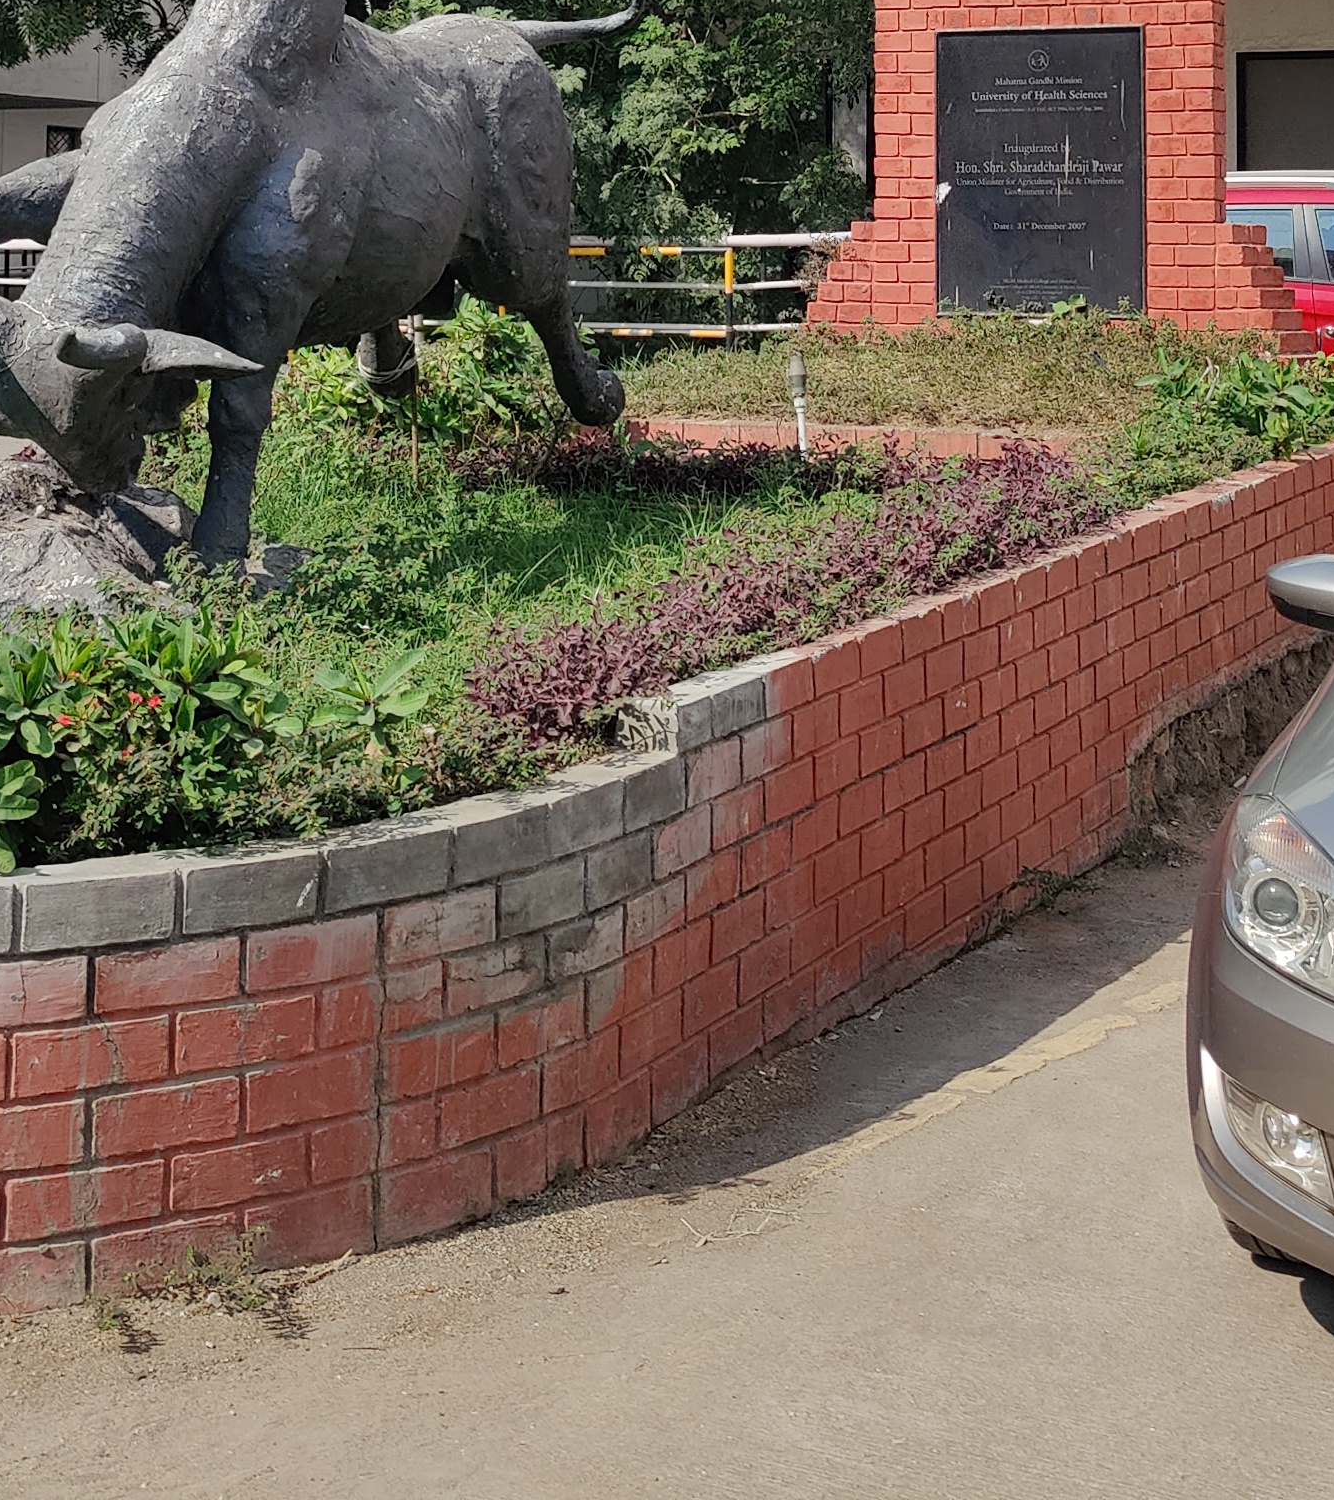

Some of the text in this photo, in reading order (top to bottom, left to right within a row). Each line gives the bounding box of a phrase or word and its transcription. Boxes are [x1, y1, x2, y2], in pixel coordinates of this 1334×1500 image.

[1028, 76, 1054, 85] Gandhi
[971, 90, 1108, 103] University of Health Sciences
[1004, 143, 1058, 155] Inaugurated
[955, 161, 981, 173] Hon.
[983, 160, 1007, 174] Shri.
[1091, 159, 1123, 173] Pawar
[1031, 222, 1067, 230] December
[1067, 222, 1087, 230] 2007
